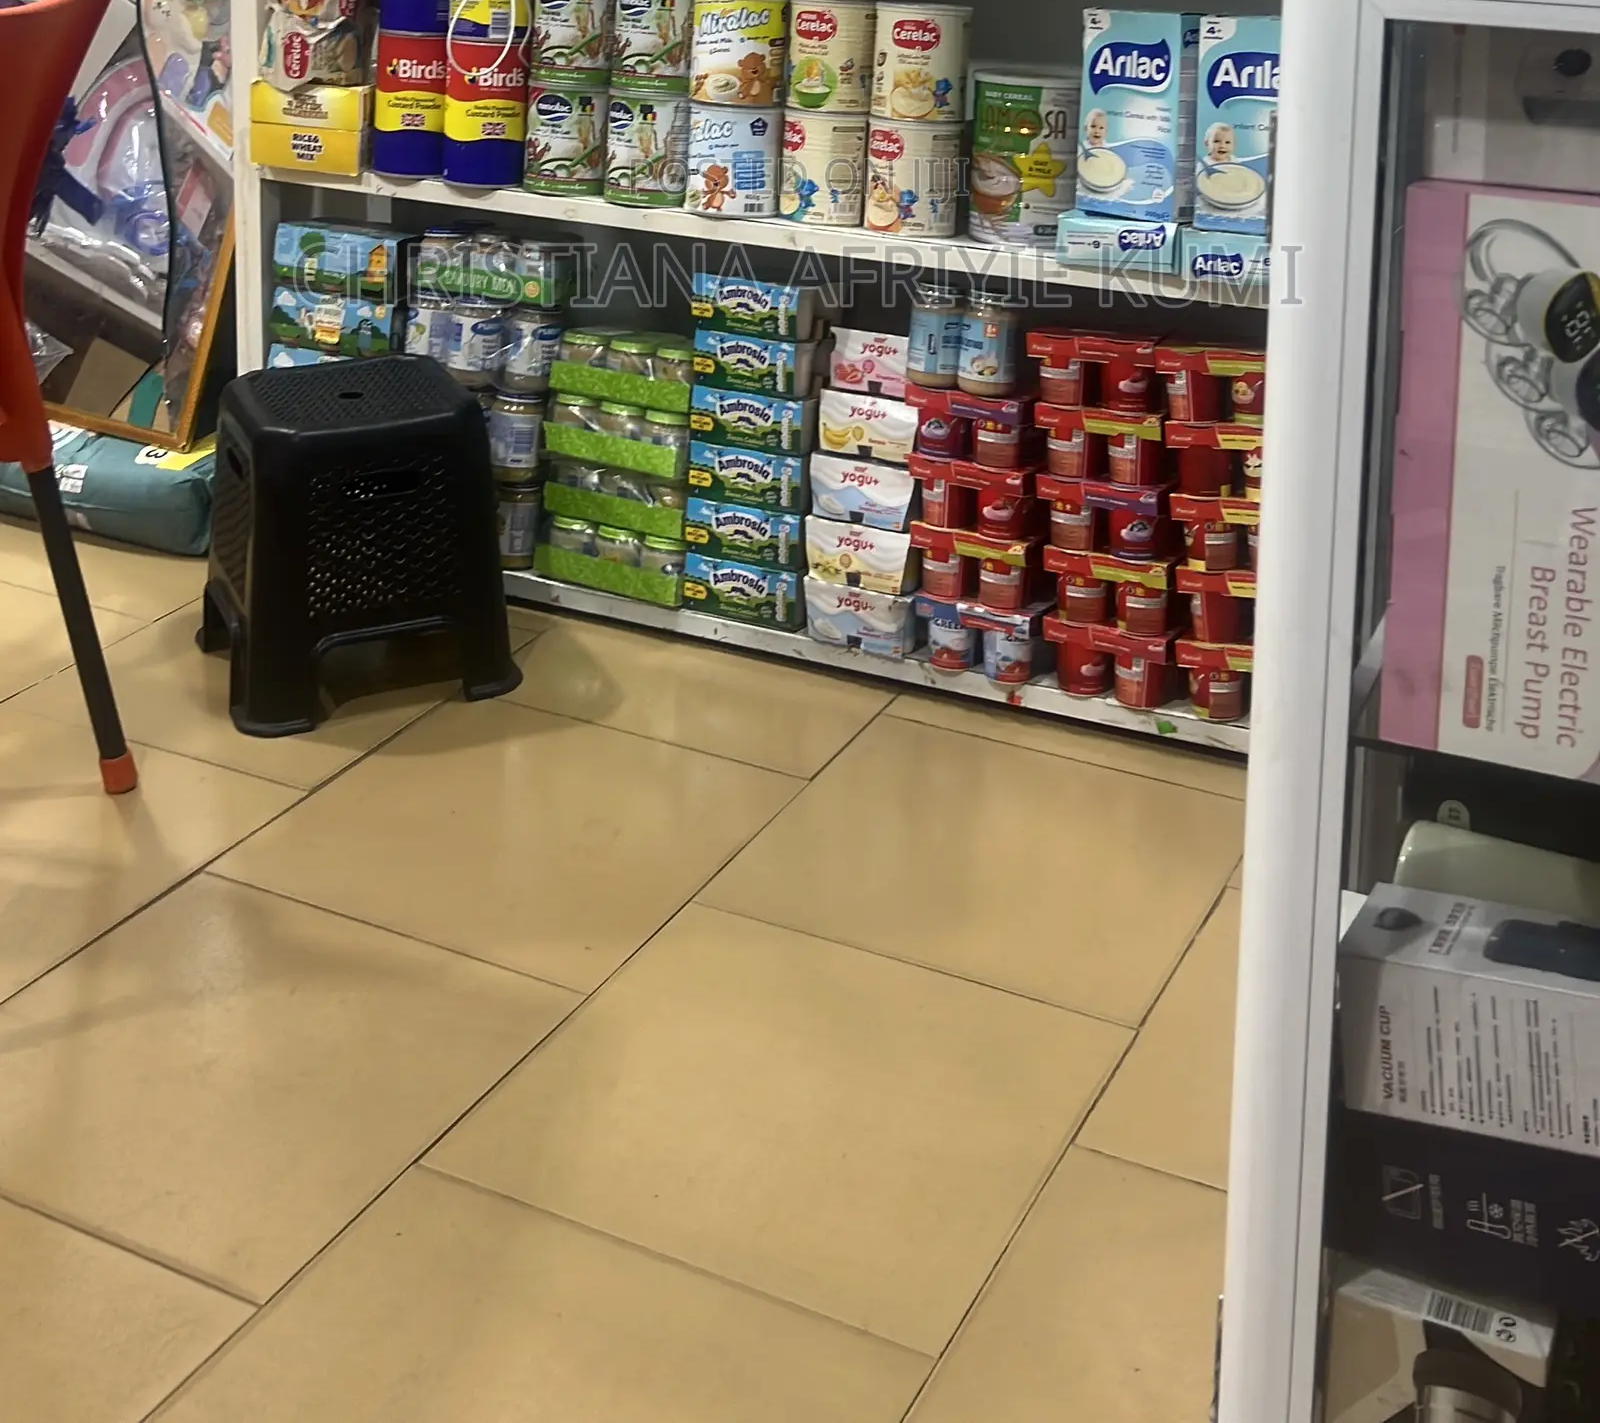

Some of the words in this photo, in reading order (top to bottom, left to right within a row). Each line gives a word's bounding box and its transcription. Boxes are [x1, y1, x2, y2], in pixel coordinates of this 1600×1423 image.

[700, 6, 770, 38] Miralac
[797, 18, 833, 33] Cerelac
[893, 28, 937, 42] Cerelac
[478, 66, 525, 87] Bird's
[1093, 47, 1167, 82] Arilac
[1194, 256, 1241, 275] Arilac
[719, 285, 769, 309] Ambrosia
[720, 341, 768, 365] Ambrosia
[860, 342, 898, 357] yogu+
[719, 400, 772, 425] Ambrosia
[848, 405, 887, 420] yogu+
[717, 455, 771, 480] Ambrosia
[841, 471, 880, 487] yogu+
[715, 510, 769, 537] Ambrosia
[836, 534, 875, 552] yogu+
[713, 569, 766, 595] Ambrosia
[1562, 506, 1599, 639] Wearable
[1526, 565, 1556, 653] Breast
[1514, 660, 1550, 740] Pump
[1556, 646, 1590, 749] Electric
[1379, 1004, 1393, 1036] CUP
[1379, 1038, 1395, 1101] VACUUM
